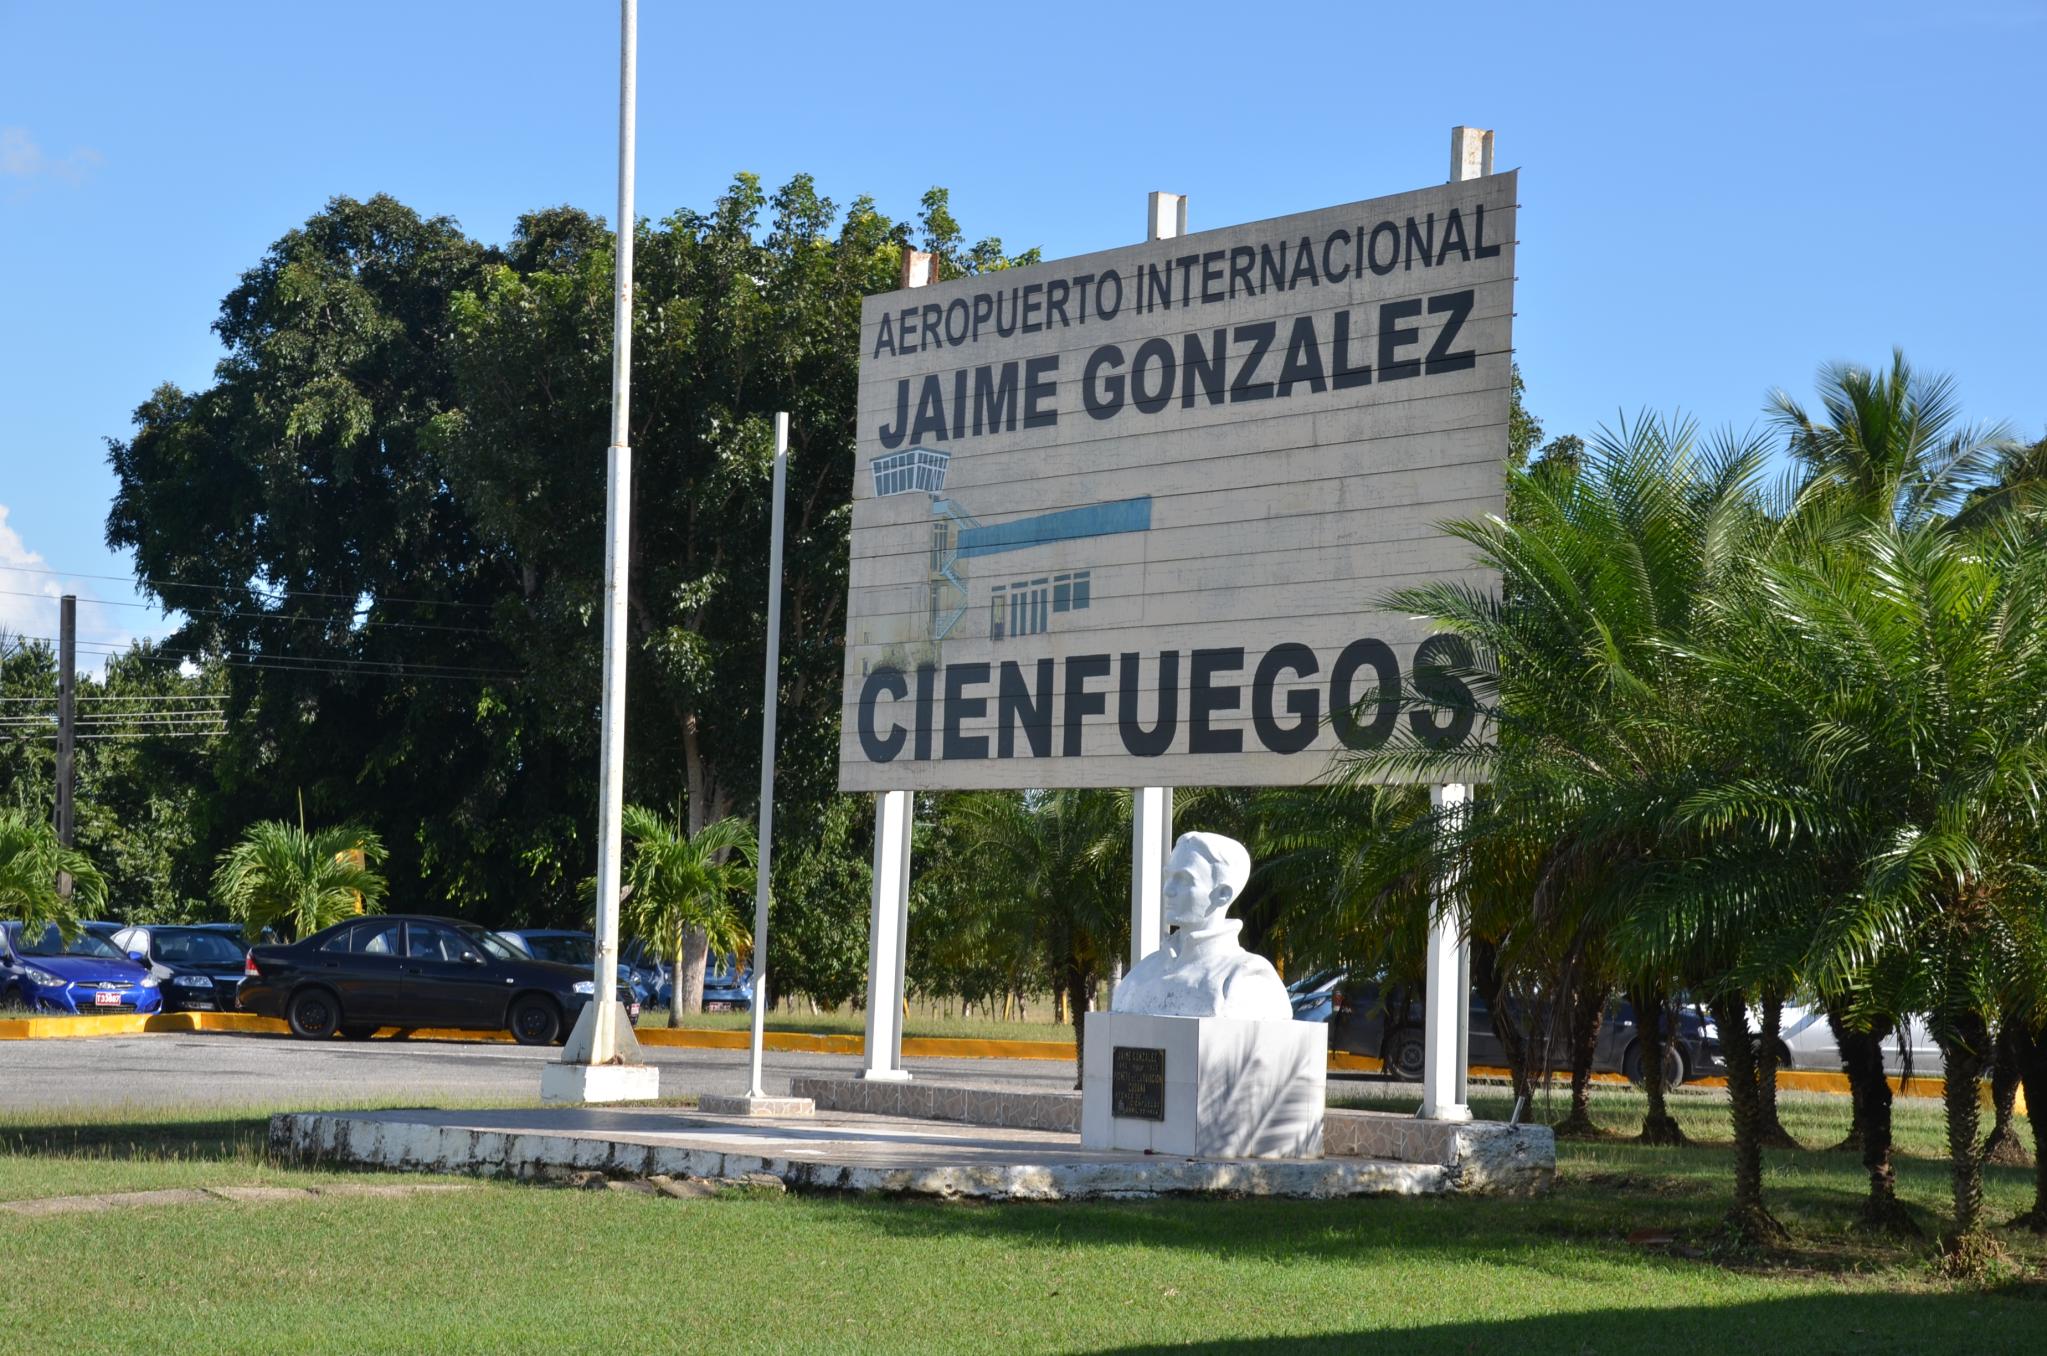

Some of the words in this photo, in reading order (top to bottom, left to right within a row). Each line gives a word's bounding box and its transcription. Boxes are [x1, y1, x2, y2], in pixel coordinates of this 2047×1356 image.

[874, 269, 1122, 359] AEROPUERTO
[1137, 204, 1501, 315] INTERNACIONAL
[879, 354, 1059, 448] JAIME
[1083, 289, 1476, 420] GONZALEZ
[858, 633, 1476, 763] CIENFUEGOS
